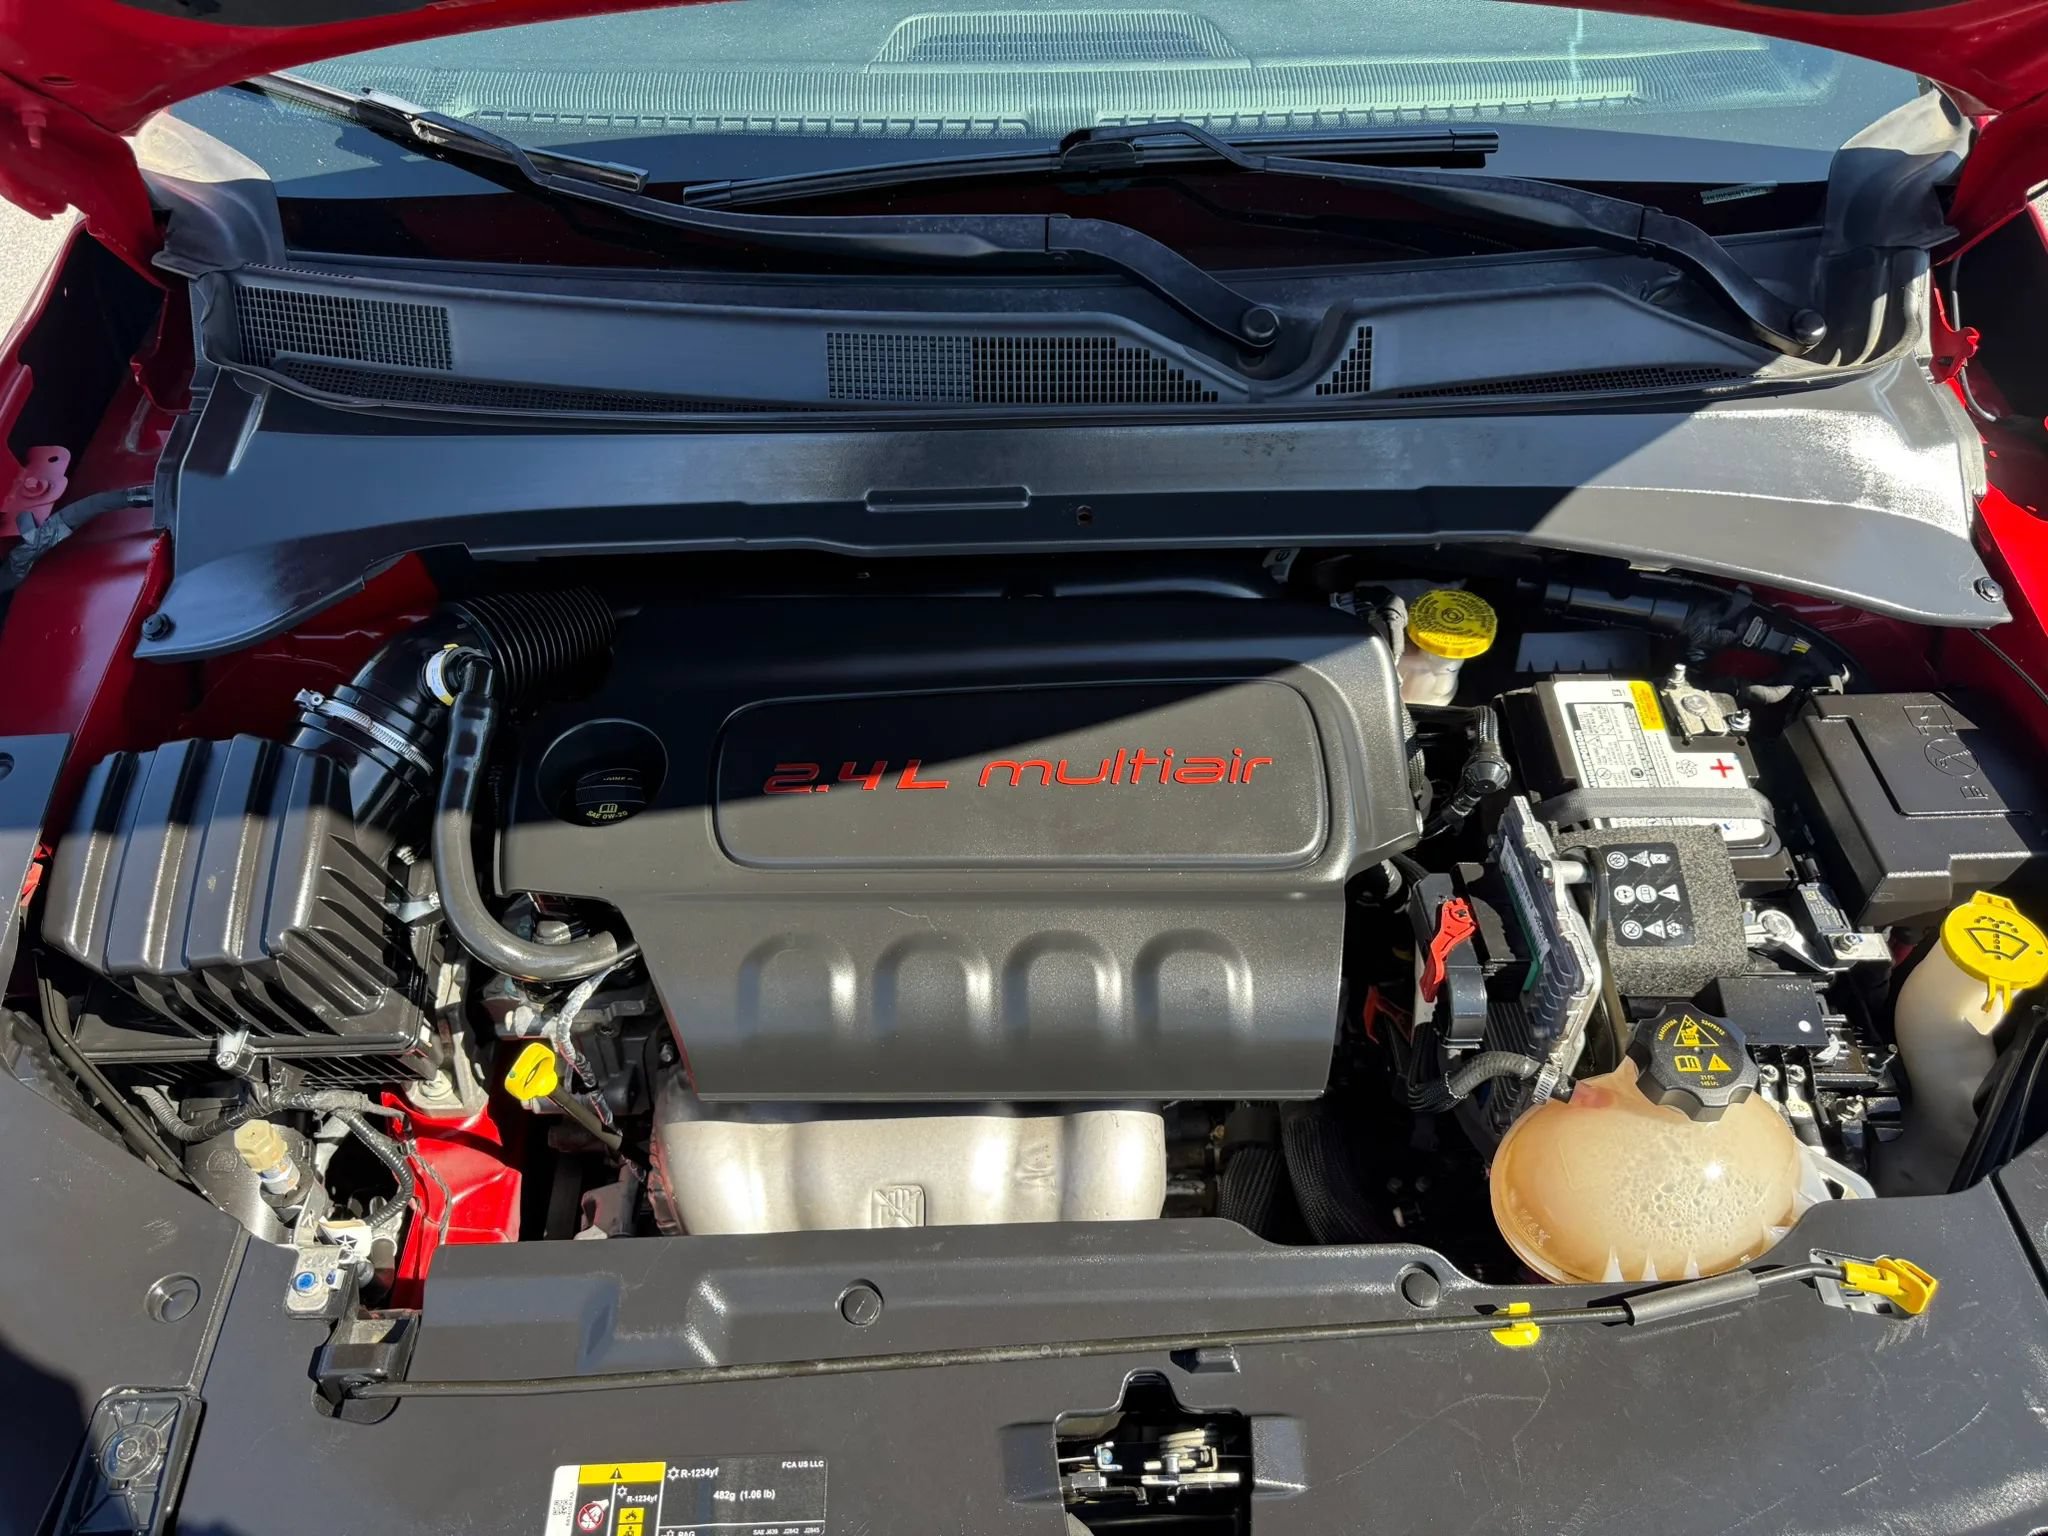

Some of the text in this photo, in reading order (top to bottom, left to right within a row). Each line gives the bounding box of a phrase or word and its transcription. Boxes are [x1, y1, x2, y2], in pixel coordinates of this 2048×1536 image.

[764, 747, 1273, 794] 2.4L multiair
[586, 810, 629, 820] SAE 0W-20
[781, 1460, 824, 1469] FCA US LLC
[680, 1466, 719, 1478] R-1234yf
[626, 1494, 658, 1504] R-1234yf
[713, 1488, 776, 1502] 482g (1.06 lb)
[752, 1528, 765, 1536] SAE
